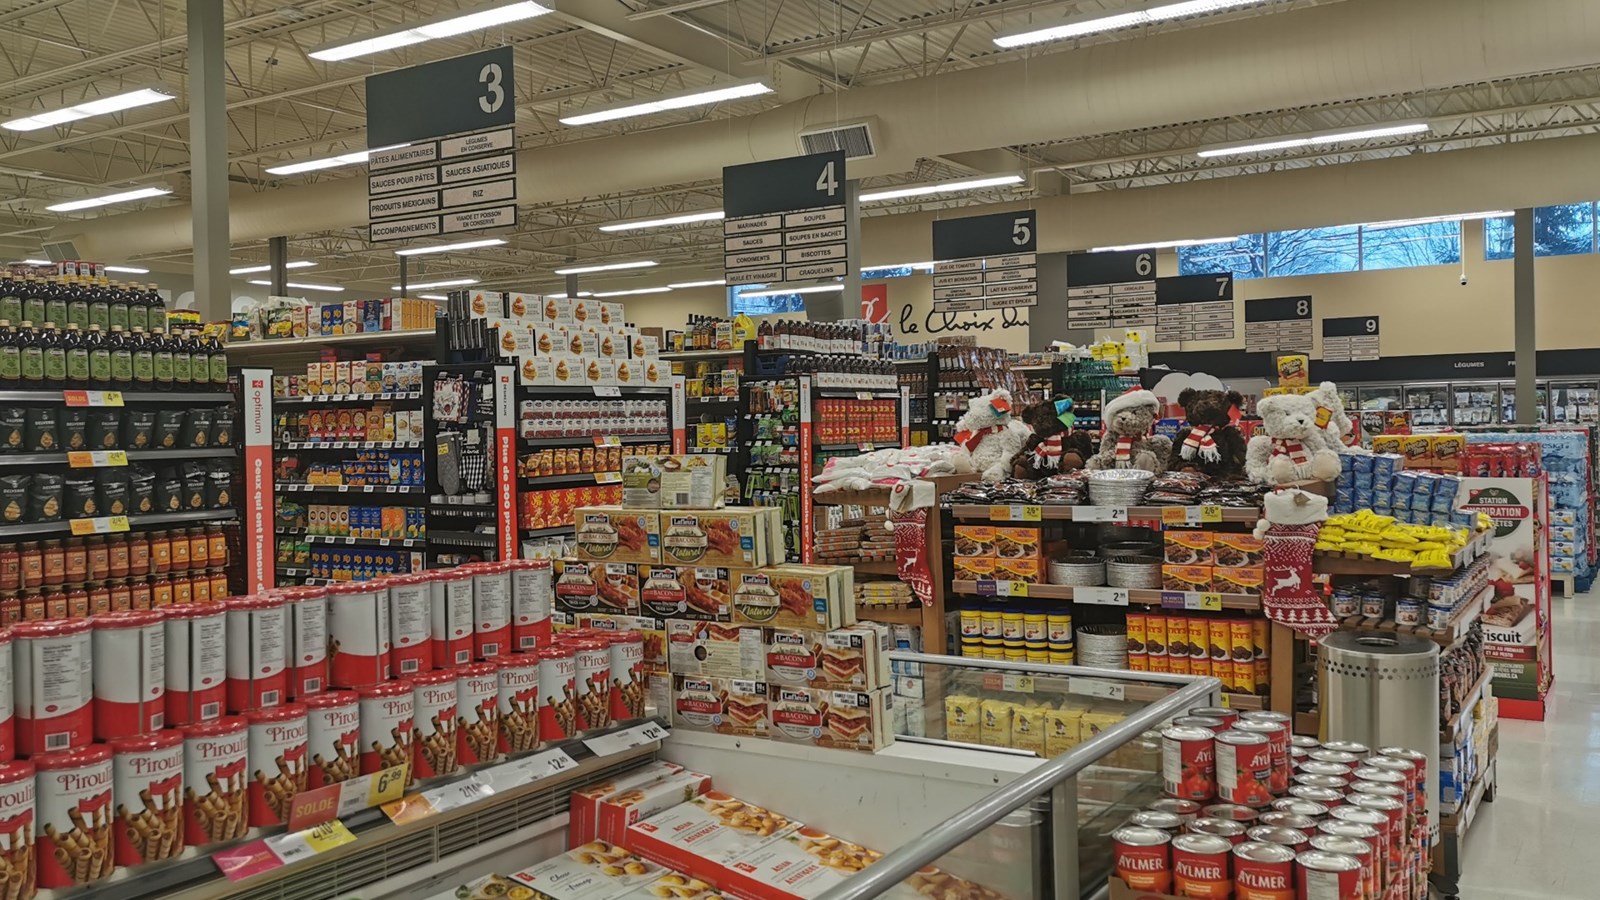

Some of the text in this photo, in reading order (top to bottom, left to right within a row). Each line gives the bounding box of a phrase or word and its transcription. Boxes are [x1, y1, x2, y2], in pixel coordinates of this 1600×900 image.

[478, 63, 504, 114] 3
[466, 136, 488, 145] LÉGUMES
[468, 142, 493, 152] CONSERVE
[370, 148, 434, 165] PÂTES ALIMENTAIRES
[445, 160, 510, 178] SAUCES ASIATIQUES
[371, 172, 434, 189] SAUCES POUR PÂTES
[816, 161, 838, 196] 4
[372, 196, 436, 212] PRODUITS MEXICAINS
[469, 218, 495, 227] CONSERVE
[480, 210, 501, 219] POISSON
[372, 222, 436, 236] ACCOMPAGNEMENTS
[737, 221, 767, 229] MARINADES
[1012, 218, 1030, 245] 5
[736, 255, 770, 263] CONDIMENTS
[801, 250, 831, 258] BISCOTTES
[799, 267, 833, 275] CRAQUELINS
[1135, 253, 1152, 276] 6
[1215, 277, 1229, 297] 7
[1296, 300, 1309, 315] 8
[900, 304, 918, 334] le
[1366, 319, 1376, 332] 9
[252, 391, 261, 433] optimum
[503, 466, 509, 481] de
[254, 493, 263, 510] qui
[296, 796, 334, 818] SOLDE
[1119, 855, 1163, 871] AYLMER
[1176, 861, 1221, 879] AYLMER
[1238, 870, 1286, 888] AYLMER
